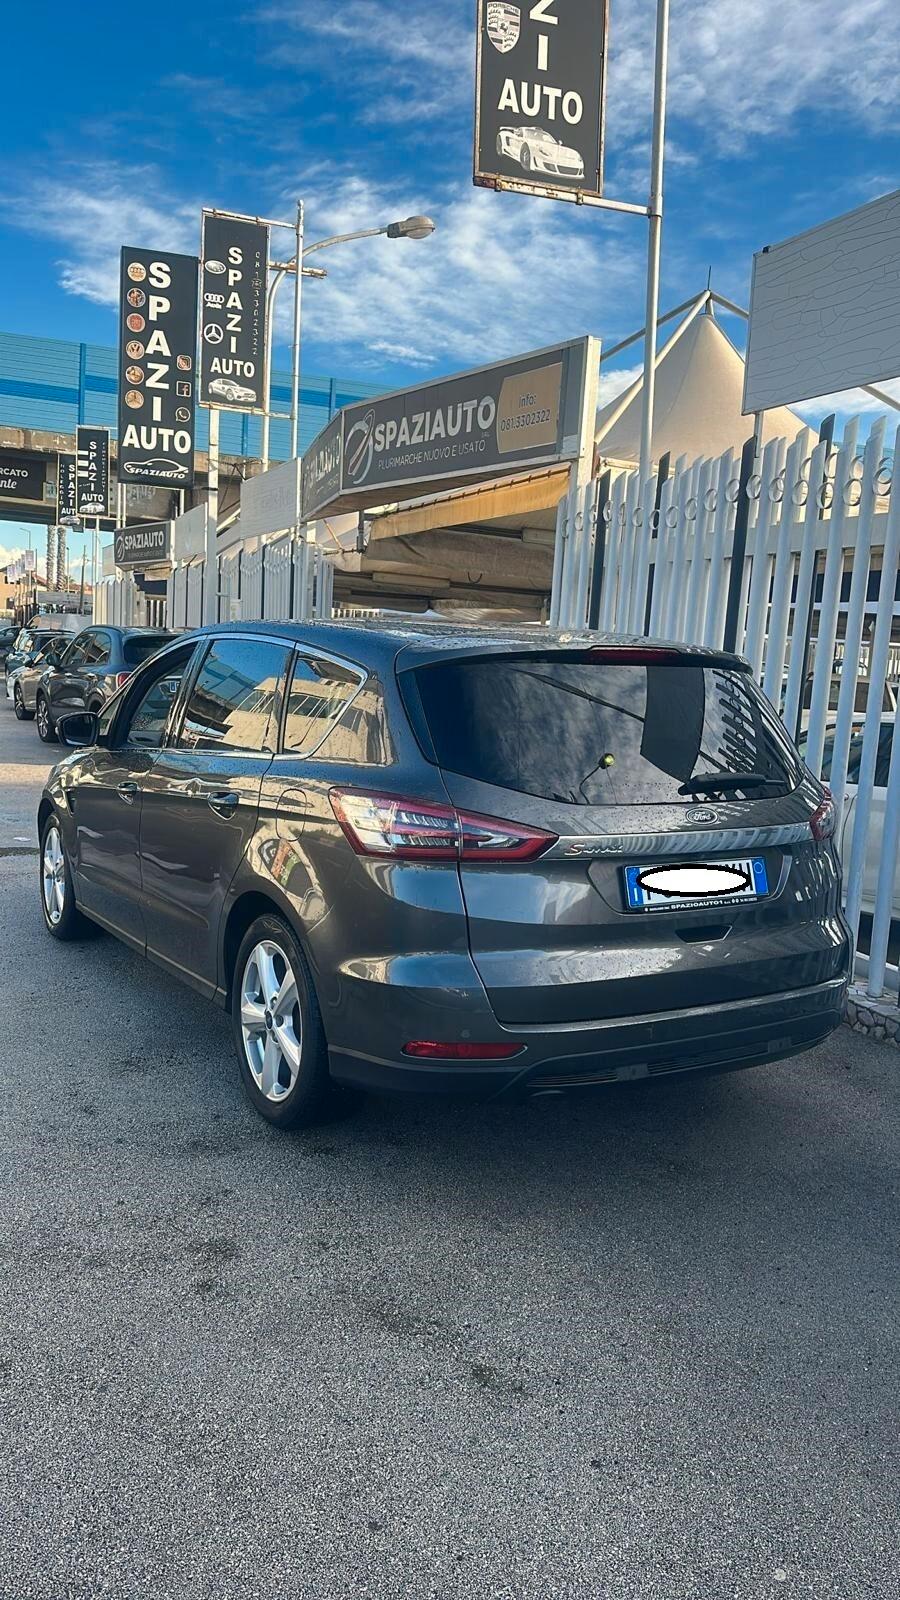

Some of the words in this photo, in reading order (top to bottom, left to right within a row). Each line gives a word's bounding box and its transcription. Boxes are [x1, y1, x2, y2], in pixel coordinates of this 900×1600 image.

[497, 78, 583, 125] AUTO
[226, 246, 243, 354] SPAZI
[145, 261, 172, 422] SPAZI
[210, 357, 256, 378] AUTO
[374, 395, 496, 453] SPAZIAUTO
[500, 409, 551, 431] 081.3302322
[121, 424, 192, 454] AUTO
[89, 441, 97, 491] SPAZI
[379, 452, 422, 470] PLURIMARCHE
[423, 446, 450, 462] NUOVO
[451, 444, 457, 457] E
[458, 439, 486, 455] USATO
[128, 467, 186, 479] SPAZIAUTO
[81, 493, 104, 502] AUTO
[124, 530, 164, 550] SPAZIAUTO
